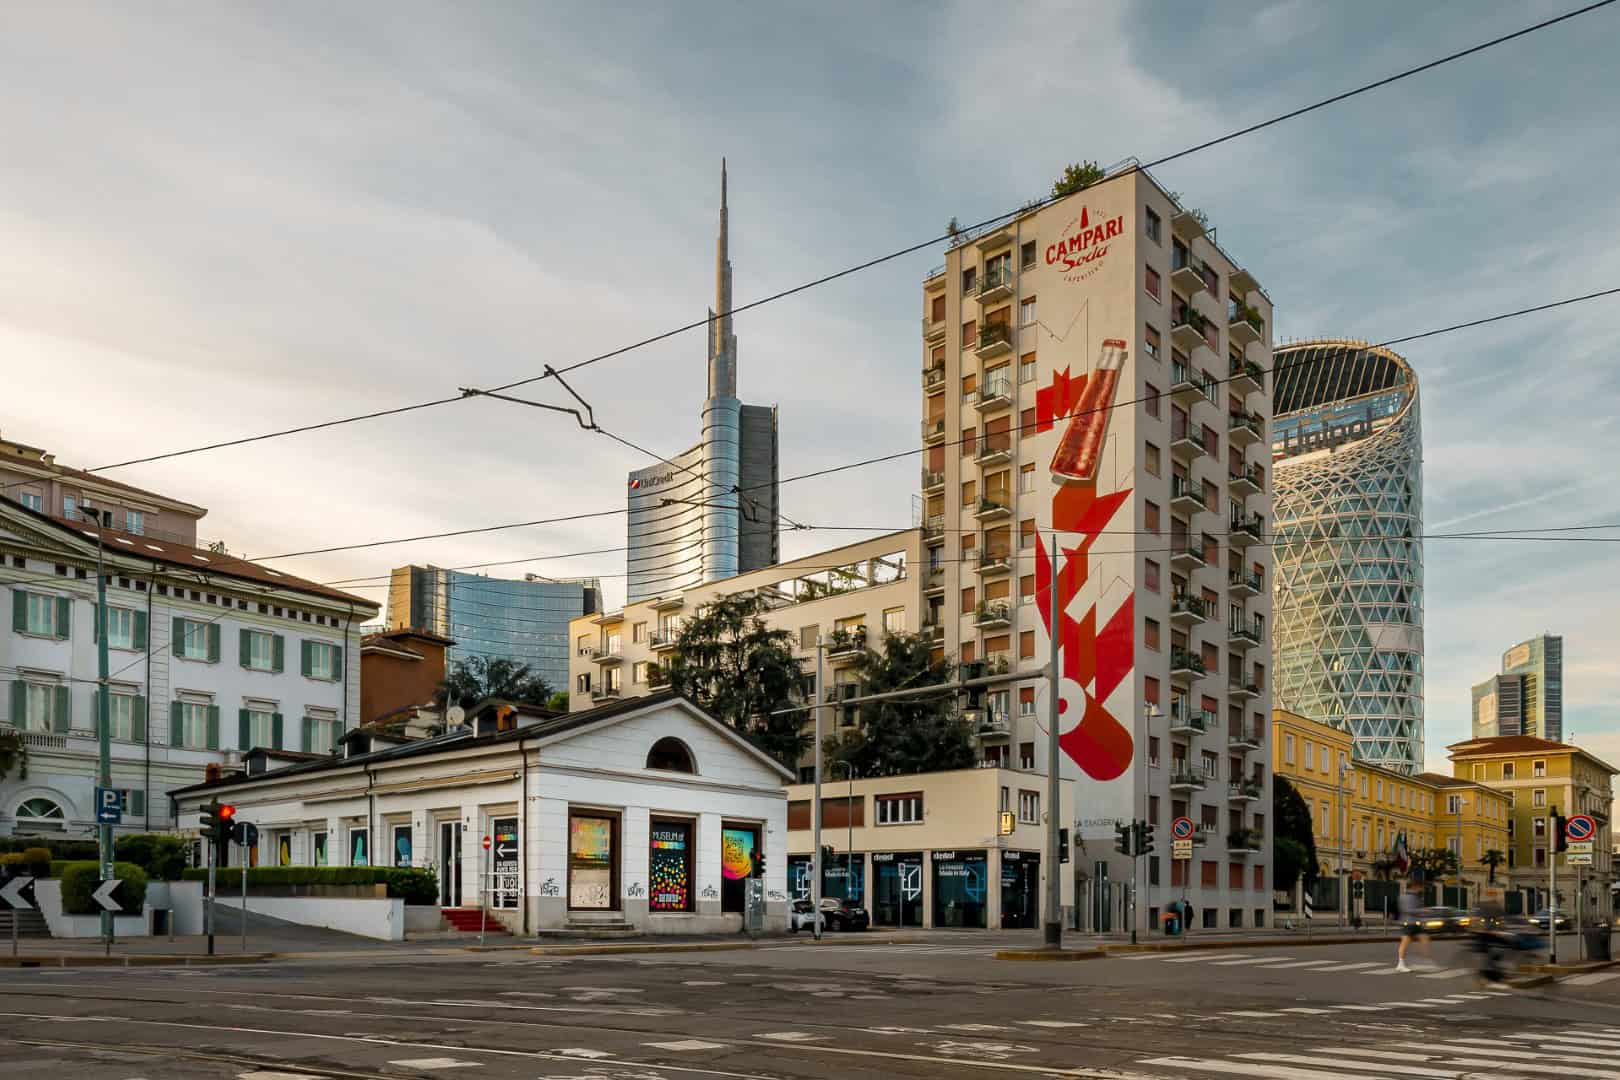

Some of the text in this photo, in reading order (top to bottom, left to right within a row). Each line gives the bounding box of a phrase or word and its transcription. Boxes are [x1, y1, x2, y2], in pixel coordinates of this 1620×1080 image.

[1046, 215, 1123, 265] CAMPARI
[1058, 245, 1110, 273] Soda
[103, 790, 116, 807] P
[652, 831, 677, 841] MUSEUM
